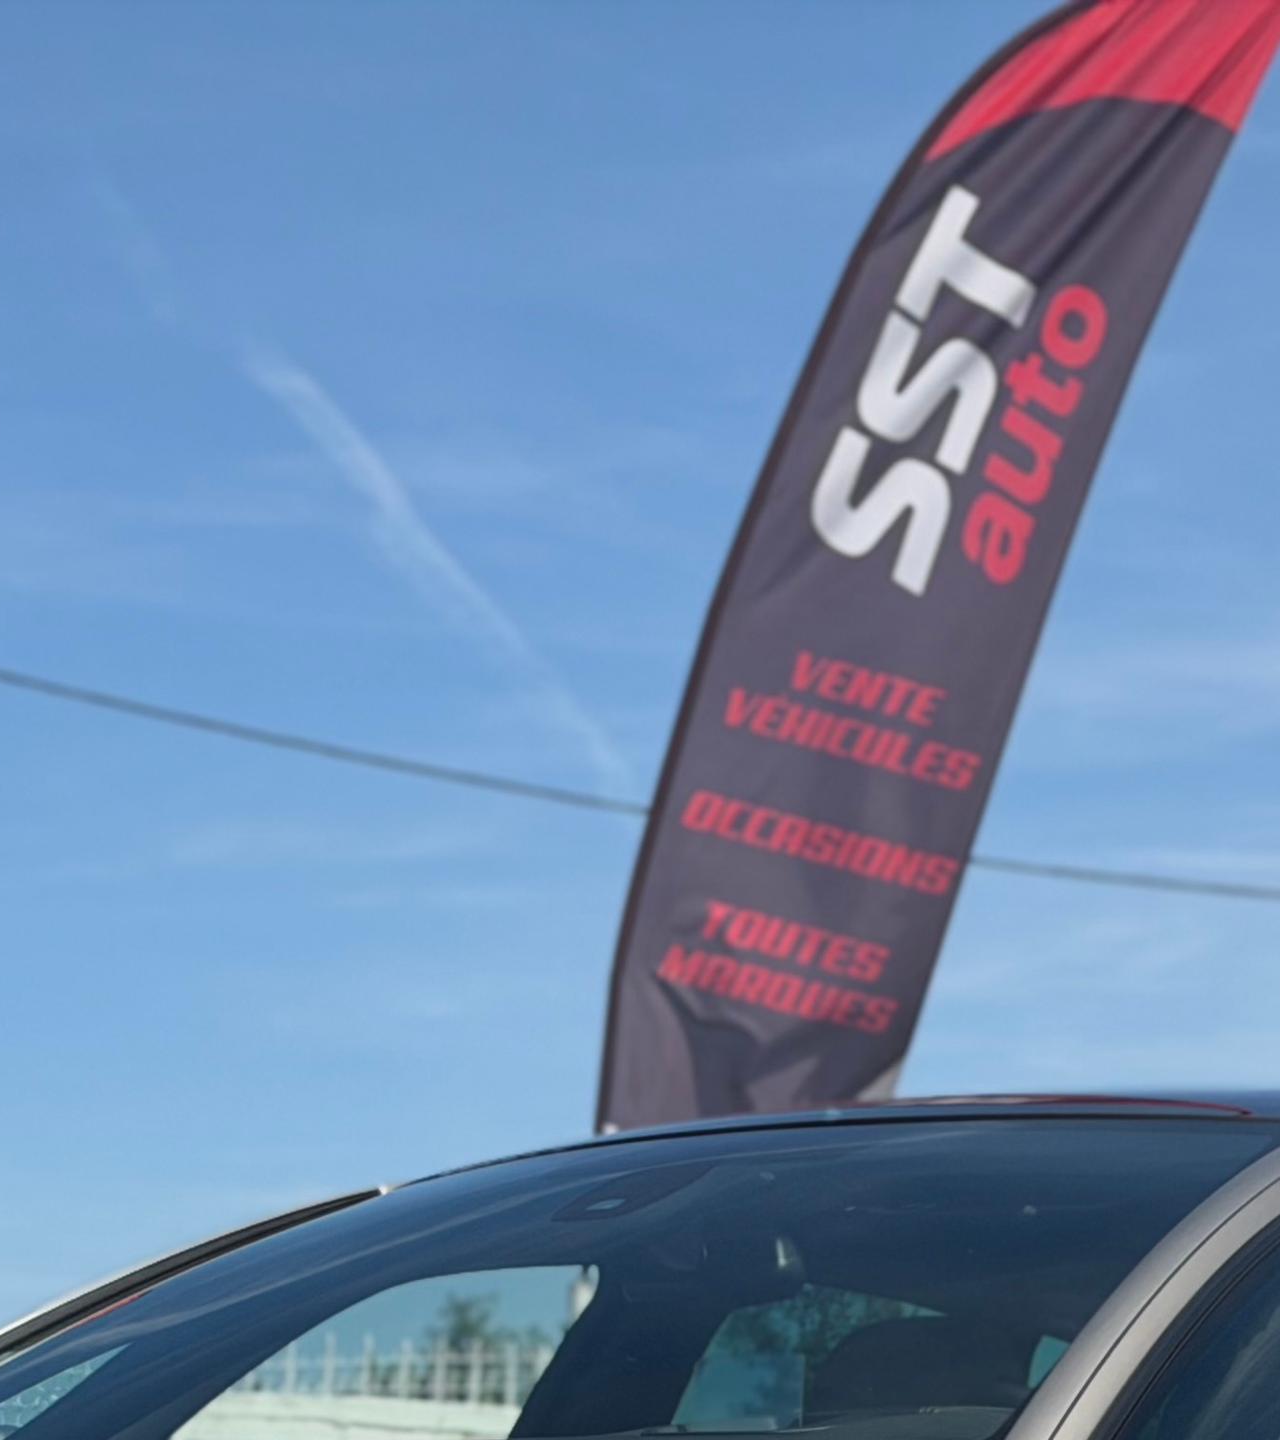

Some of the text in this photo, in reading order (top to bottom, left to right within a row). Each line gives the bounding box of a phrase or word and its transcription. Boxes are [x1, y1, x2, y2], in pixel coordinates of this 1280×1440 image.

[811, 184, 1036, 597] SST
[961, 285, 1108, 584] auto
[791, 651, 948, 728] VENTE
[681, 790, 960, 895] OCCASIONS
[655, 943, 898, 1034] MARQUES
[702, 899, 891, 983] TOUTES
